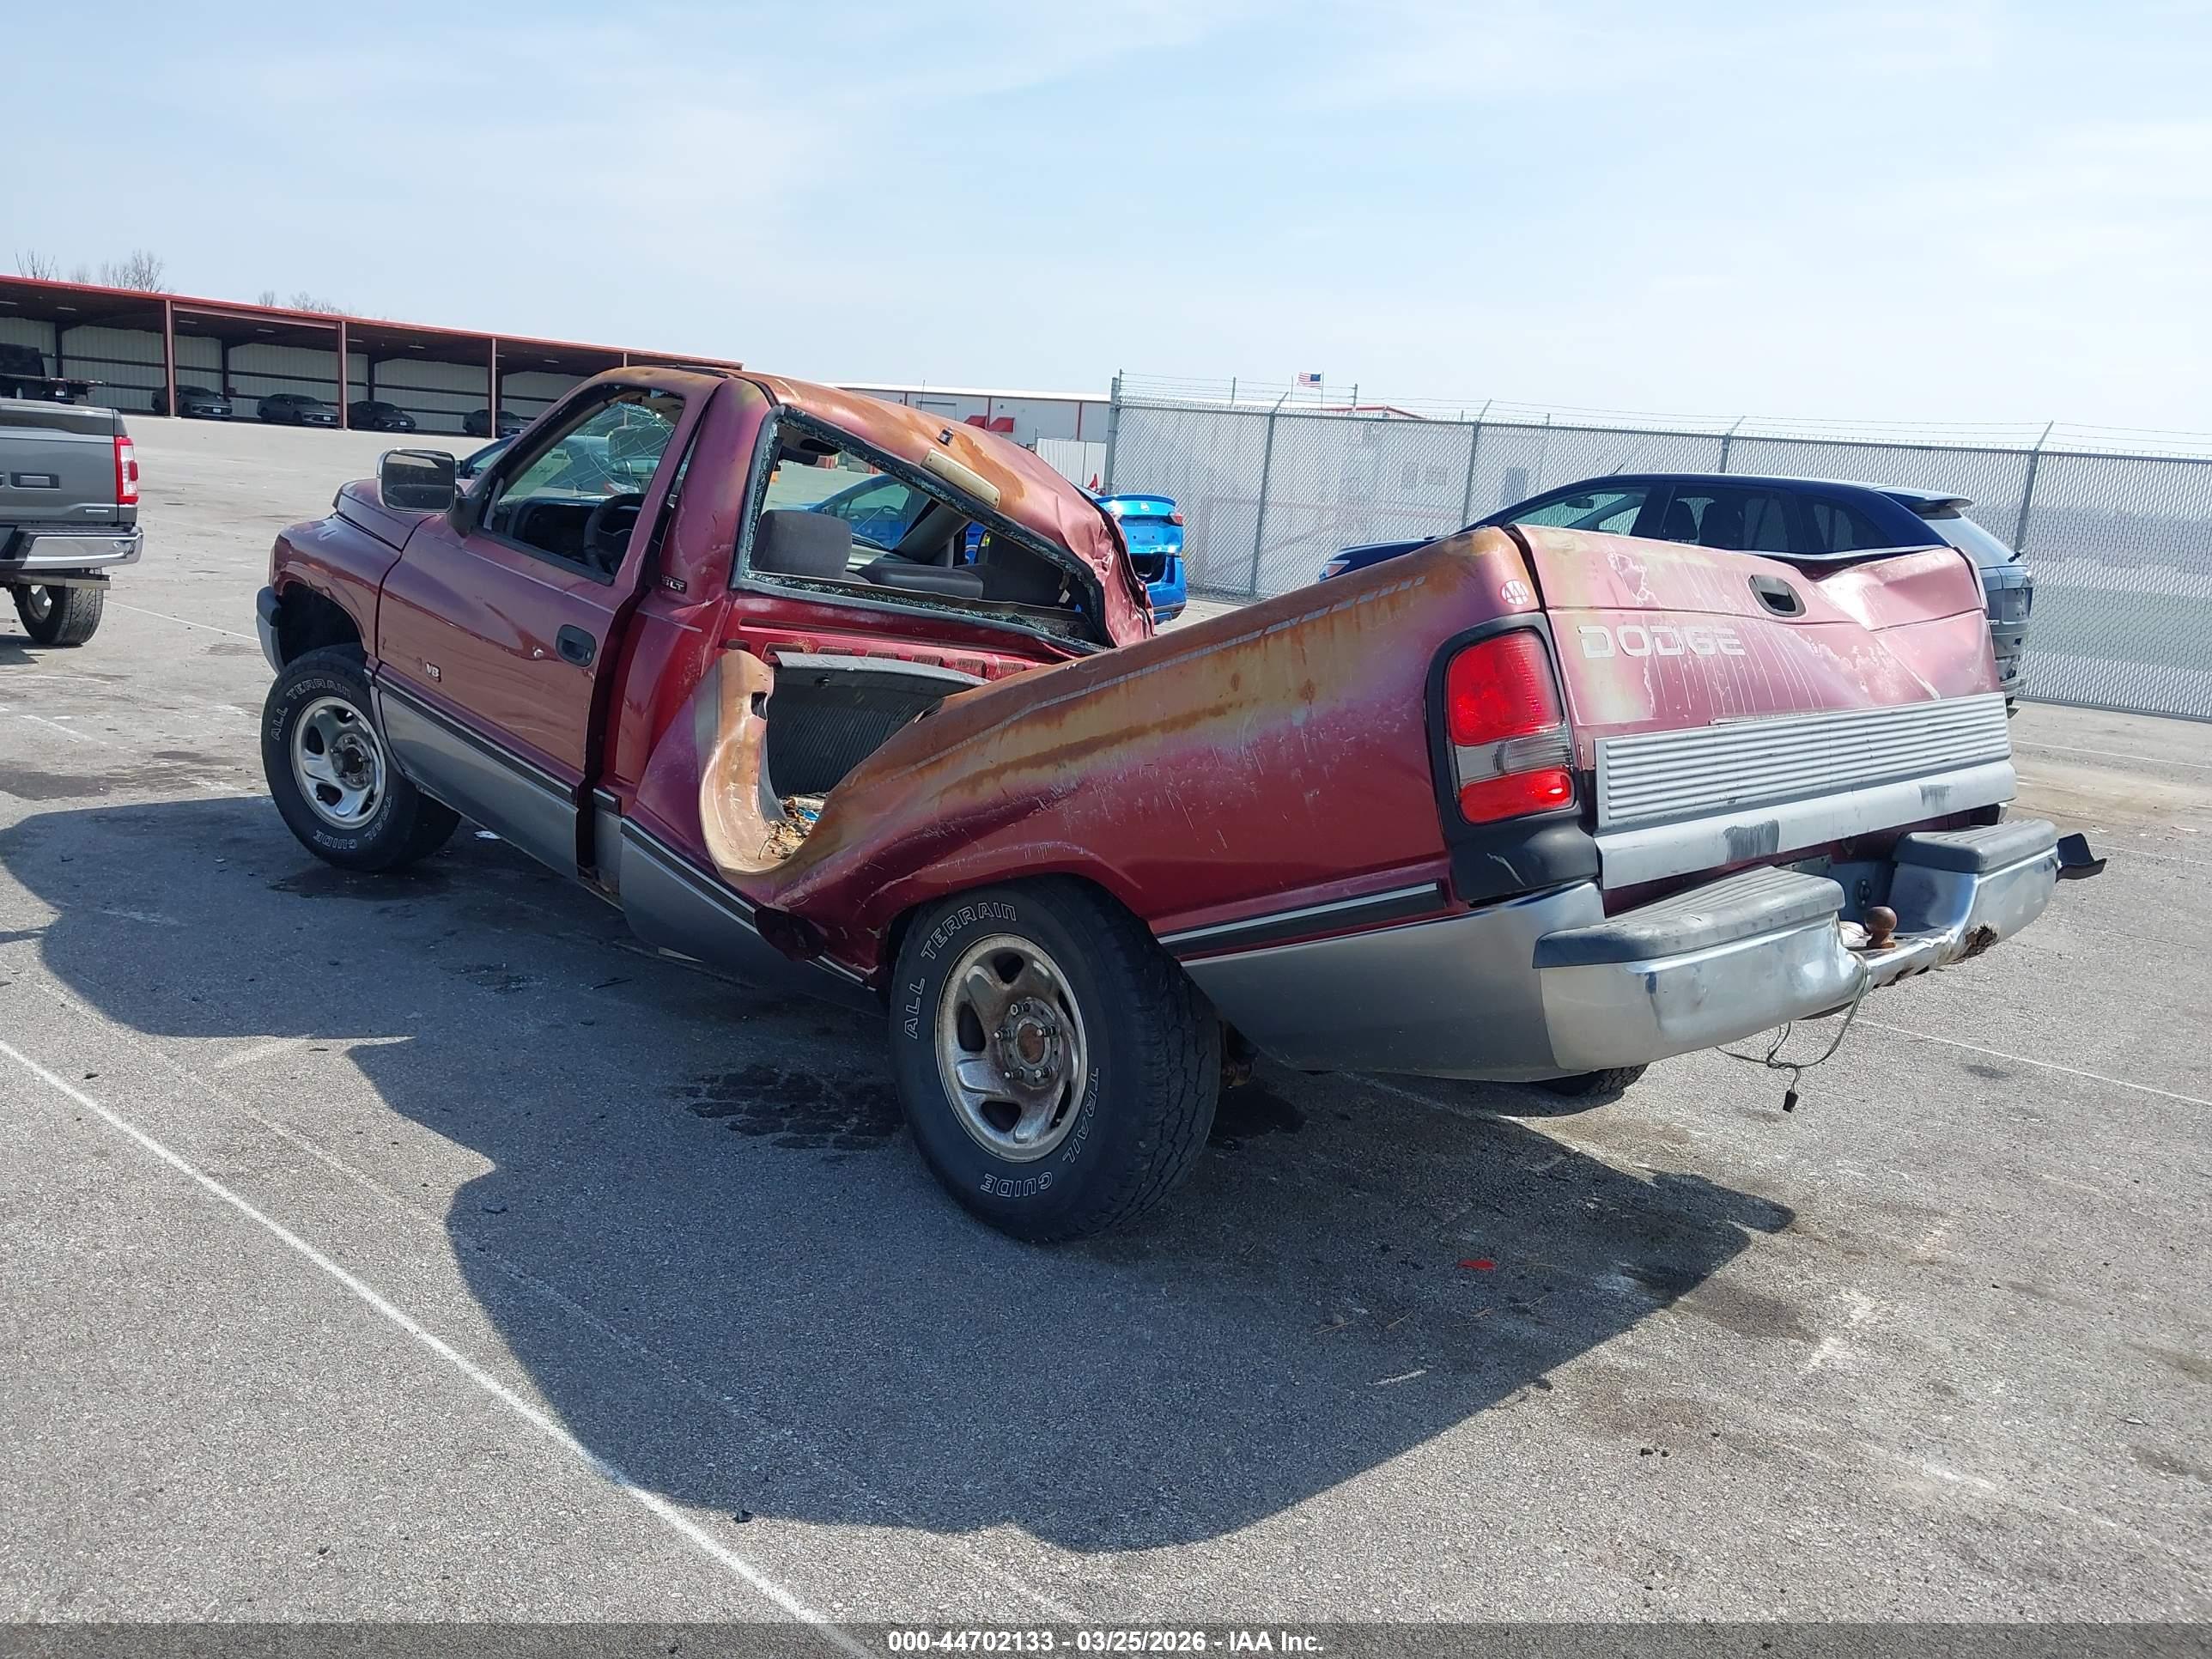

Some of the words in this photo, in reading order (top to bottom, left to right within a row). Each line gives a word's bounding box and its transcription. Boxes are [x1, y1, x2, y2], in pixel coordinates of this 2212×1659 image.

[1577, 625, 1746, 659] DODGE
[426, 662, 440, 678] V8
[270, 707, 289, 742] ALL
[285, 678, 351, 700] TERRAIN
[364, 795, 392, 841] TRAIL
[313, 830, 358, 849] GUIDE
[904, 977, 926, 1040] ALL
[920, 902, 1017, 960] TERRAIN
[1061, 1067, 1099, 1163] TRAIL
[980, 1171, 1053, 1198] GUIDE
